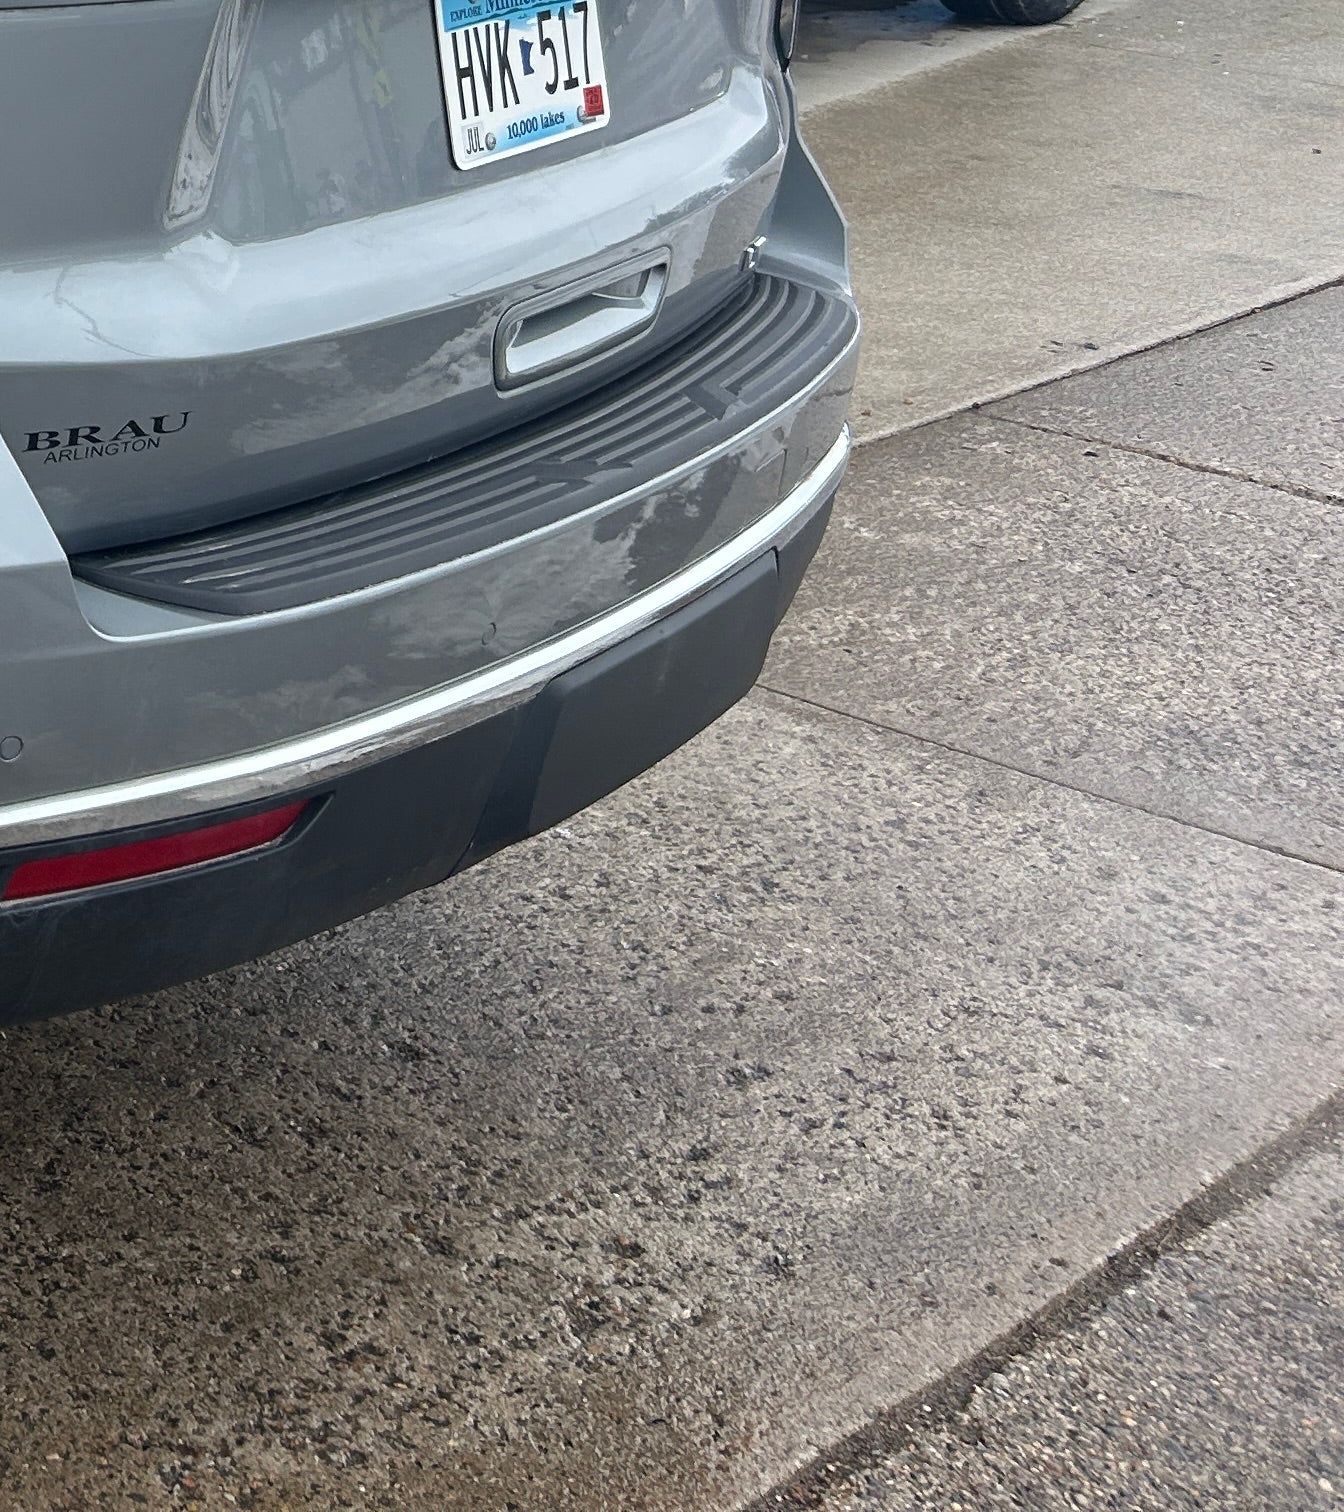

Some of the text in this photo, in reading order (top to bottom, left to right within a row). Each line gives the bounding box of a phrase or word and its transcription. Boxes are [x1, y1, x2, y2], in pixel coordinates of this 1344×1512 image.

[451, 0, 591, 120] HVK 517
[506, 111, 565, 140] 10,000 lakes
[466, 126, 485, 155] JUL
[21, 411, 193, 453] BRAU
[43, 437, 161, 465] ARLINGTON
